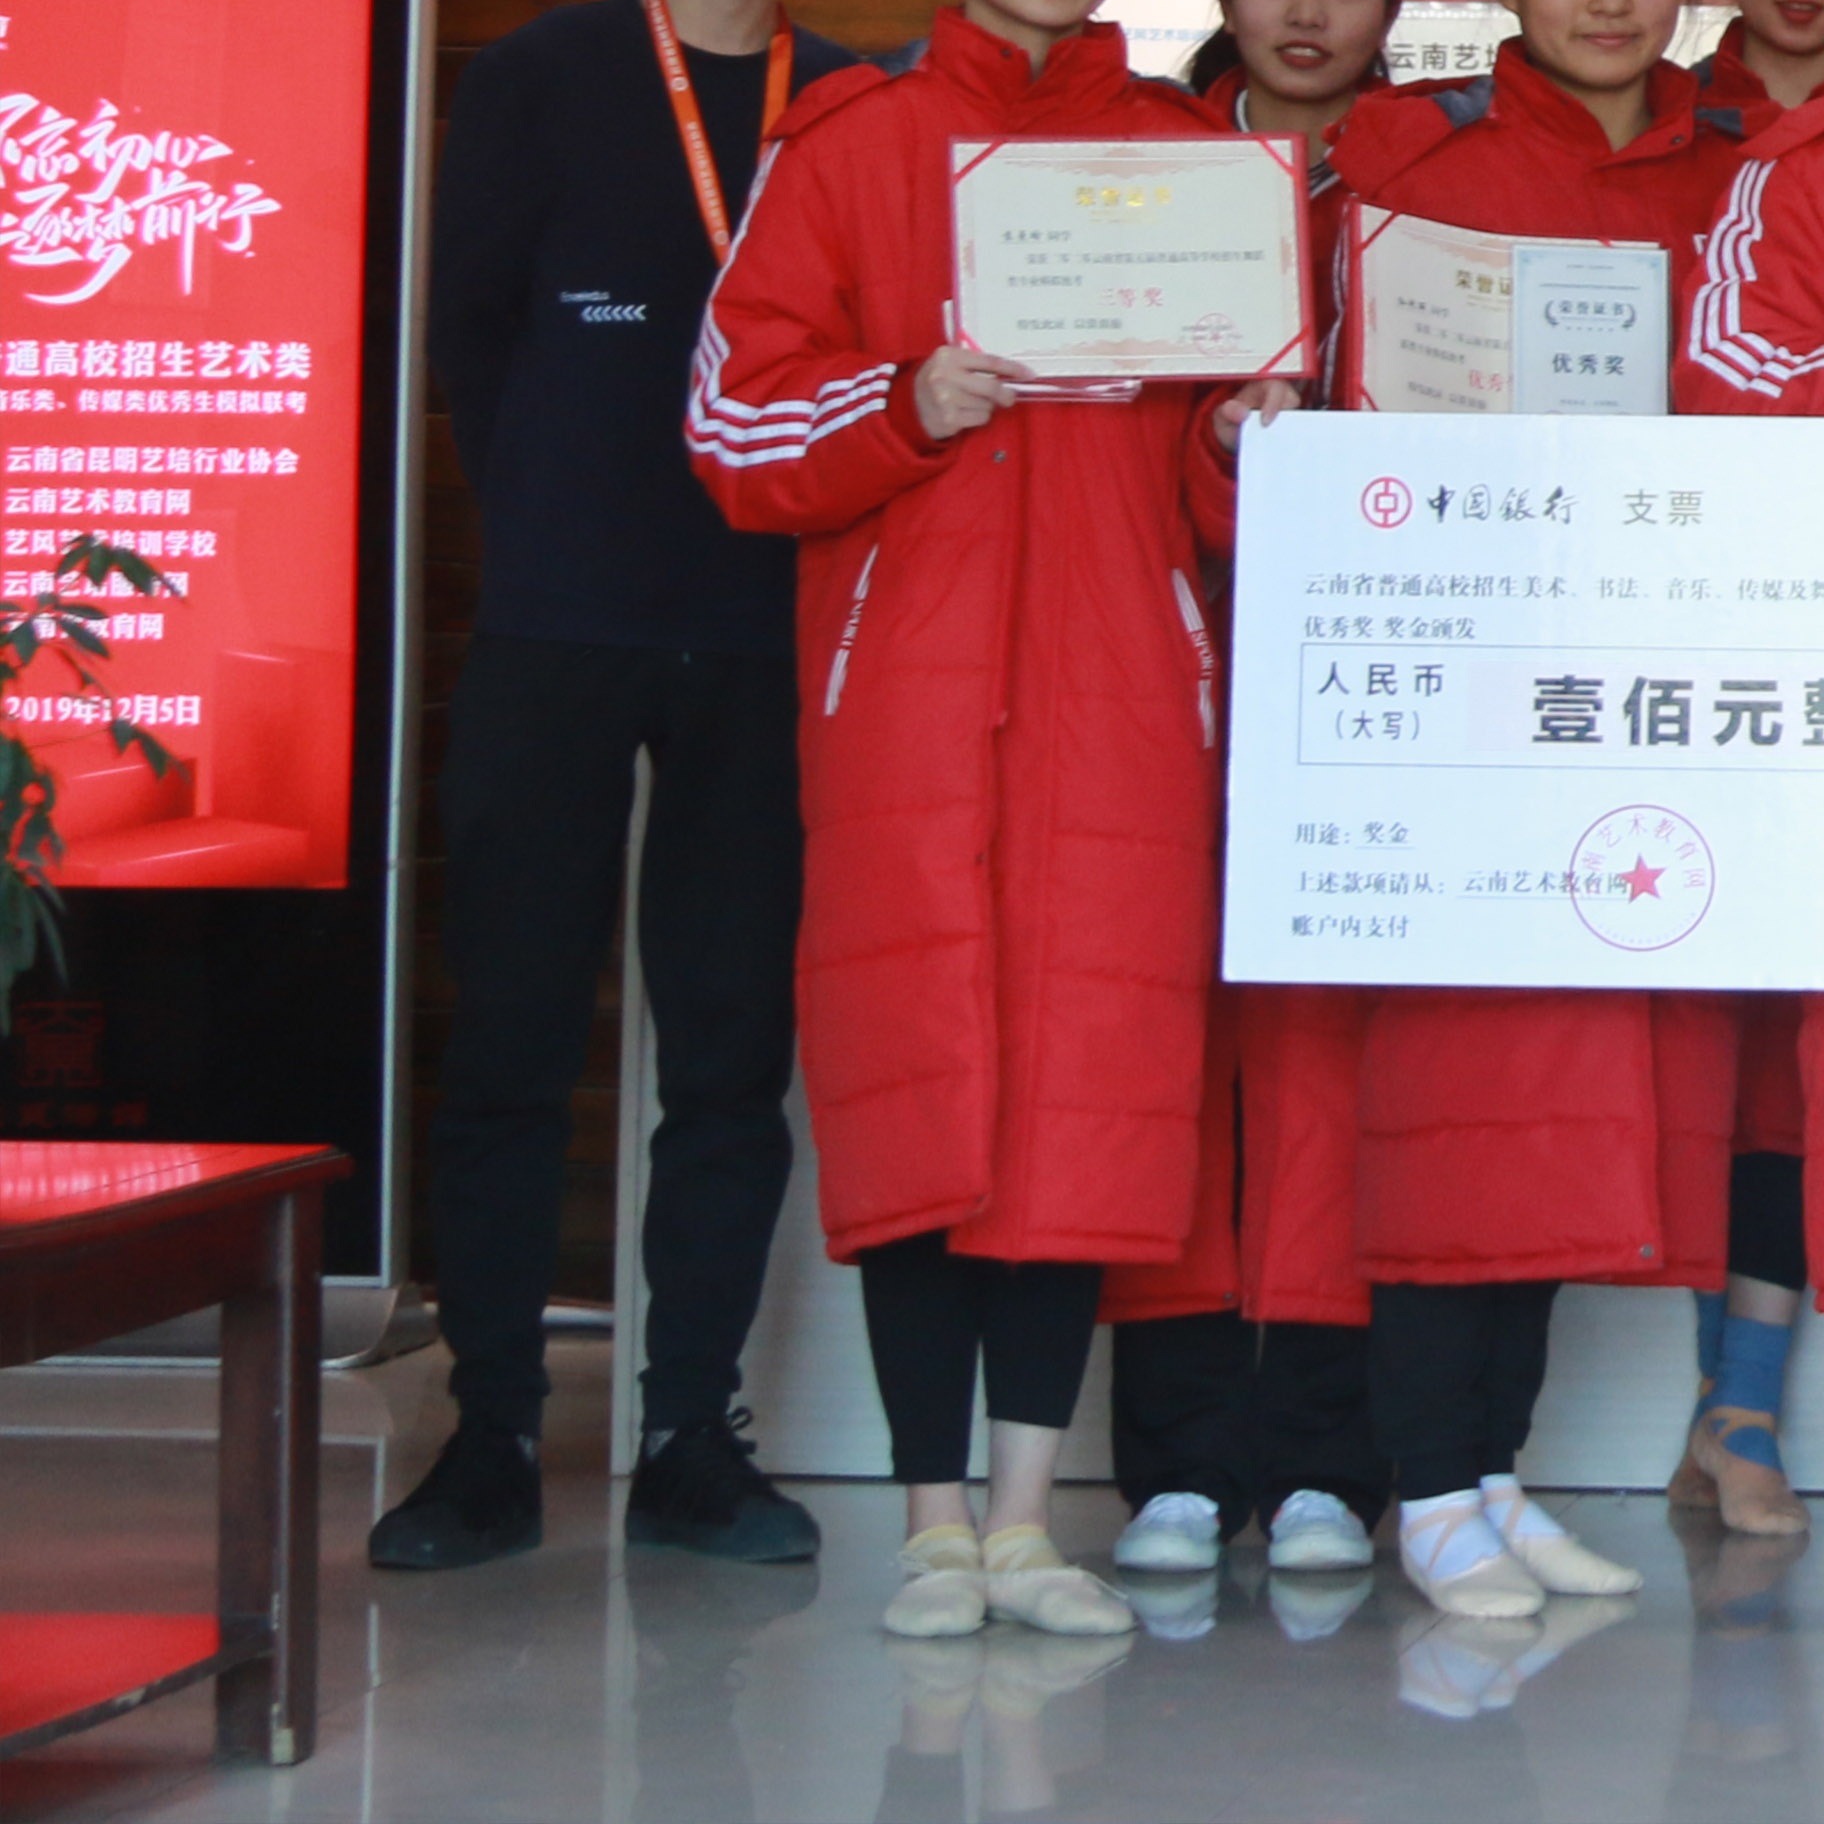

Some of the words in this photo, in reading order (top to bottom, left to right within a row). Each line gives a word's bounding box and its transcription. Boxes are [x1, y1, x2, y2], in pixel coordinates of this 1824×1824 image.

[0, 340, 312, 379] 通高校招生艺术类
[1552, 353, 1626, 376] 优秀奖
[1468, 369, 1513, 394] 优秀
[6, 447, 300, 475] 云南省昆明艺培行业协会
[4, 488, 191, 515] 云南艺术教育网
[1623, 489, 1705, 526] 支票
[1303, 616, 1374, 641] 优秀奖
[1317, 662, 1447, 699] 人民币
[6, 694, 201, 724] 2019年12月5日
[1363, 821, 1410, 845] 奖金
[1291, 914, 1409, 938] 账户内支付
